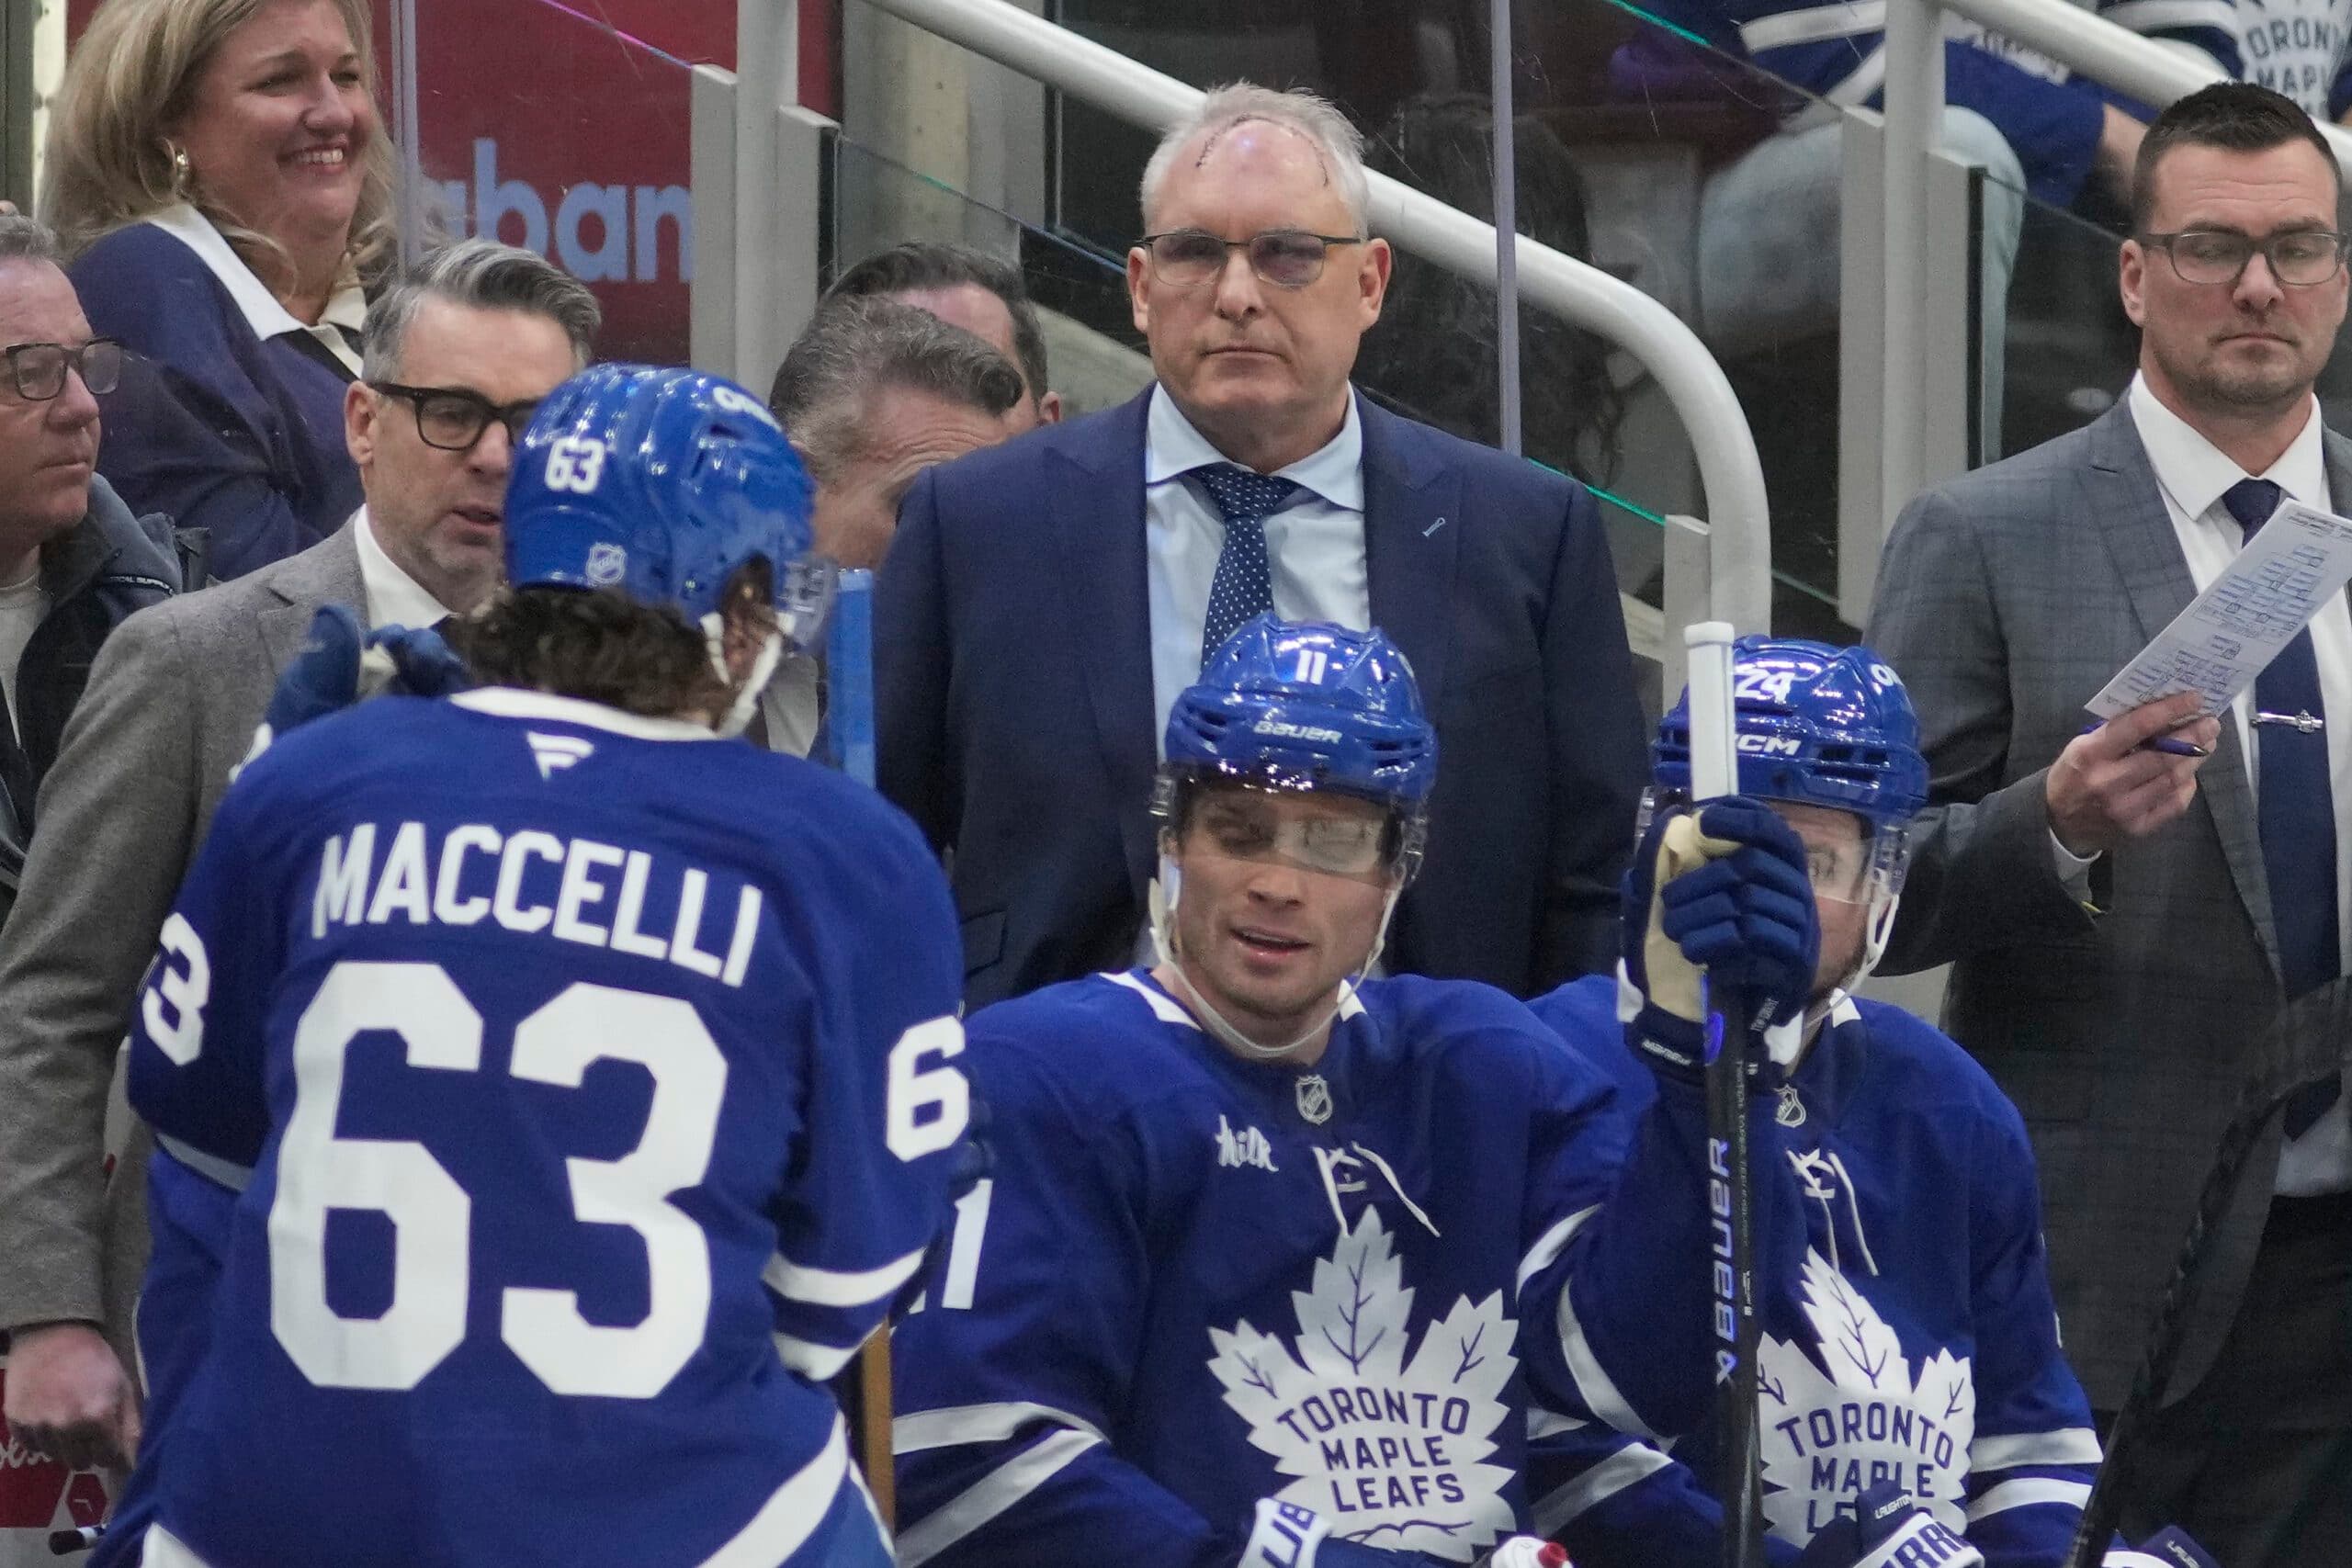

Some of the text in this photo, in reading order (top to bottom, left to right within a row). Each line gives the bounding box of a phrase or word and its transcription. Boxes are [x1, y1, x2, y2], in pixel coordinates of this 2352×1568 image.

[545, 436, 605, 493] 63
[1295, 649, 1328, 685] 11
[1735, 669, 1795, 704] 24
[1735, 734, 1801, 756] CM
[312, 823, 762, 987] MACCELLI
[887, 1014, 969, 1163] 6
[269, 961, 728, 1398] 63
[910, 1178, 993, 1314] 1
[1276, 1386, 1470, 1444] TORONTO
[1775, 1402, 1953, 1470] TORONTO
[1319, 1435, 1452, 1471] MAPLE
[1331, 1472, 1465, 1512] LEAFS
